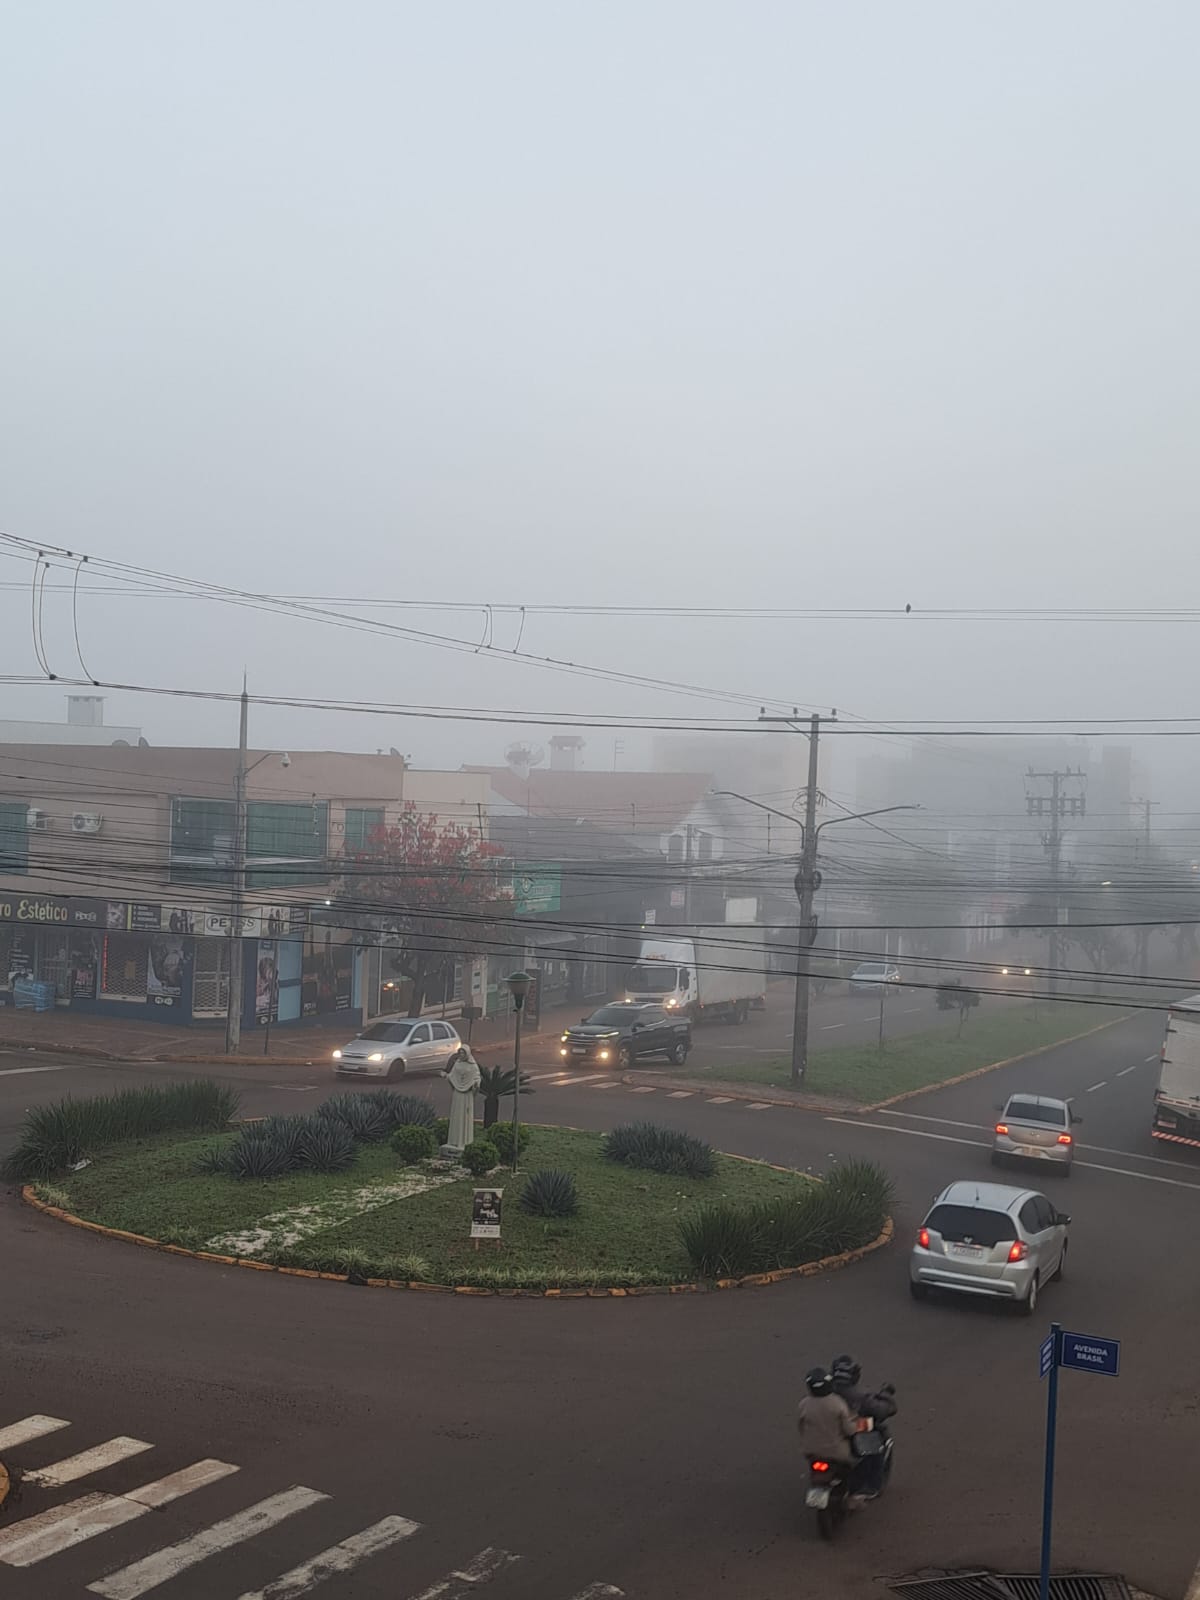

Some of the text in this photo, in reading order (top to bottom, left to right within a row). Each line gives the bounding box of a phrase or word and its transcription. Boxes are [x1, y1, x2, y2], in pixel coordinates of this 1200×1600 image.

[16, 899, 68, 921] Estético
[1073, 1344, 1108, 1356] AVENIDA
[1076, 1352, 1104, 1364] BRASIL
